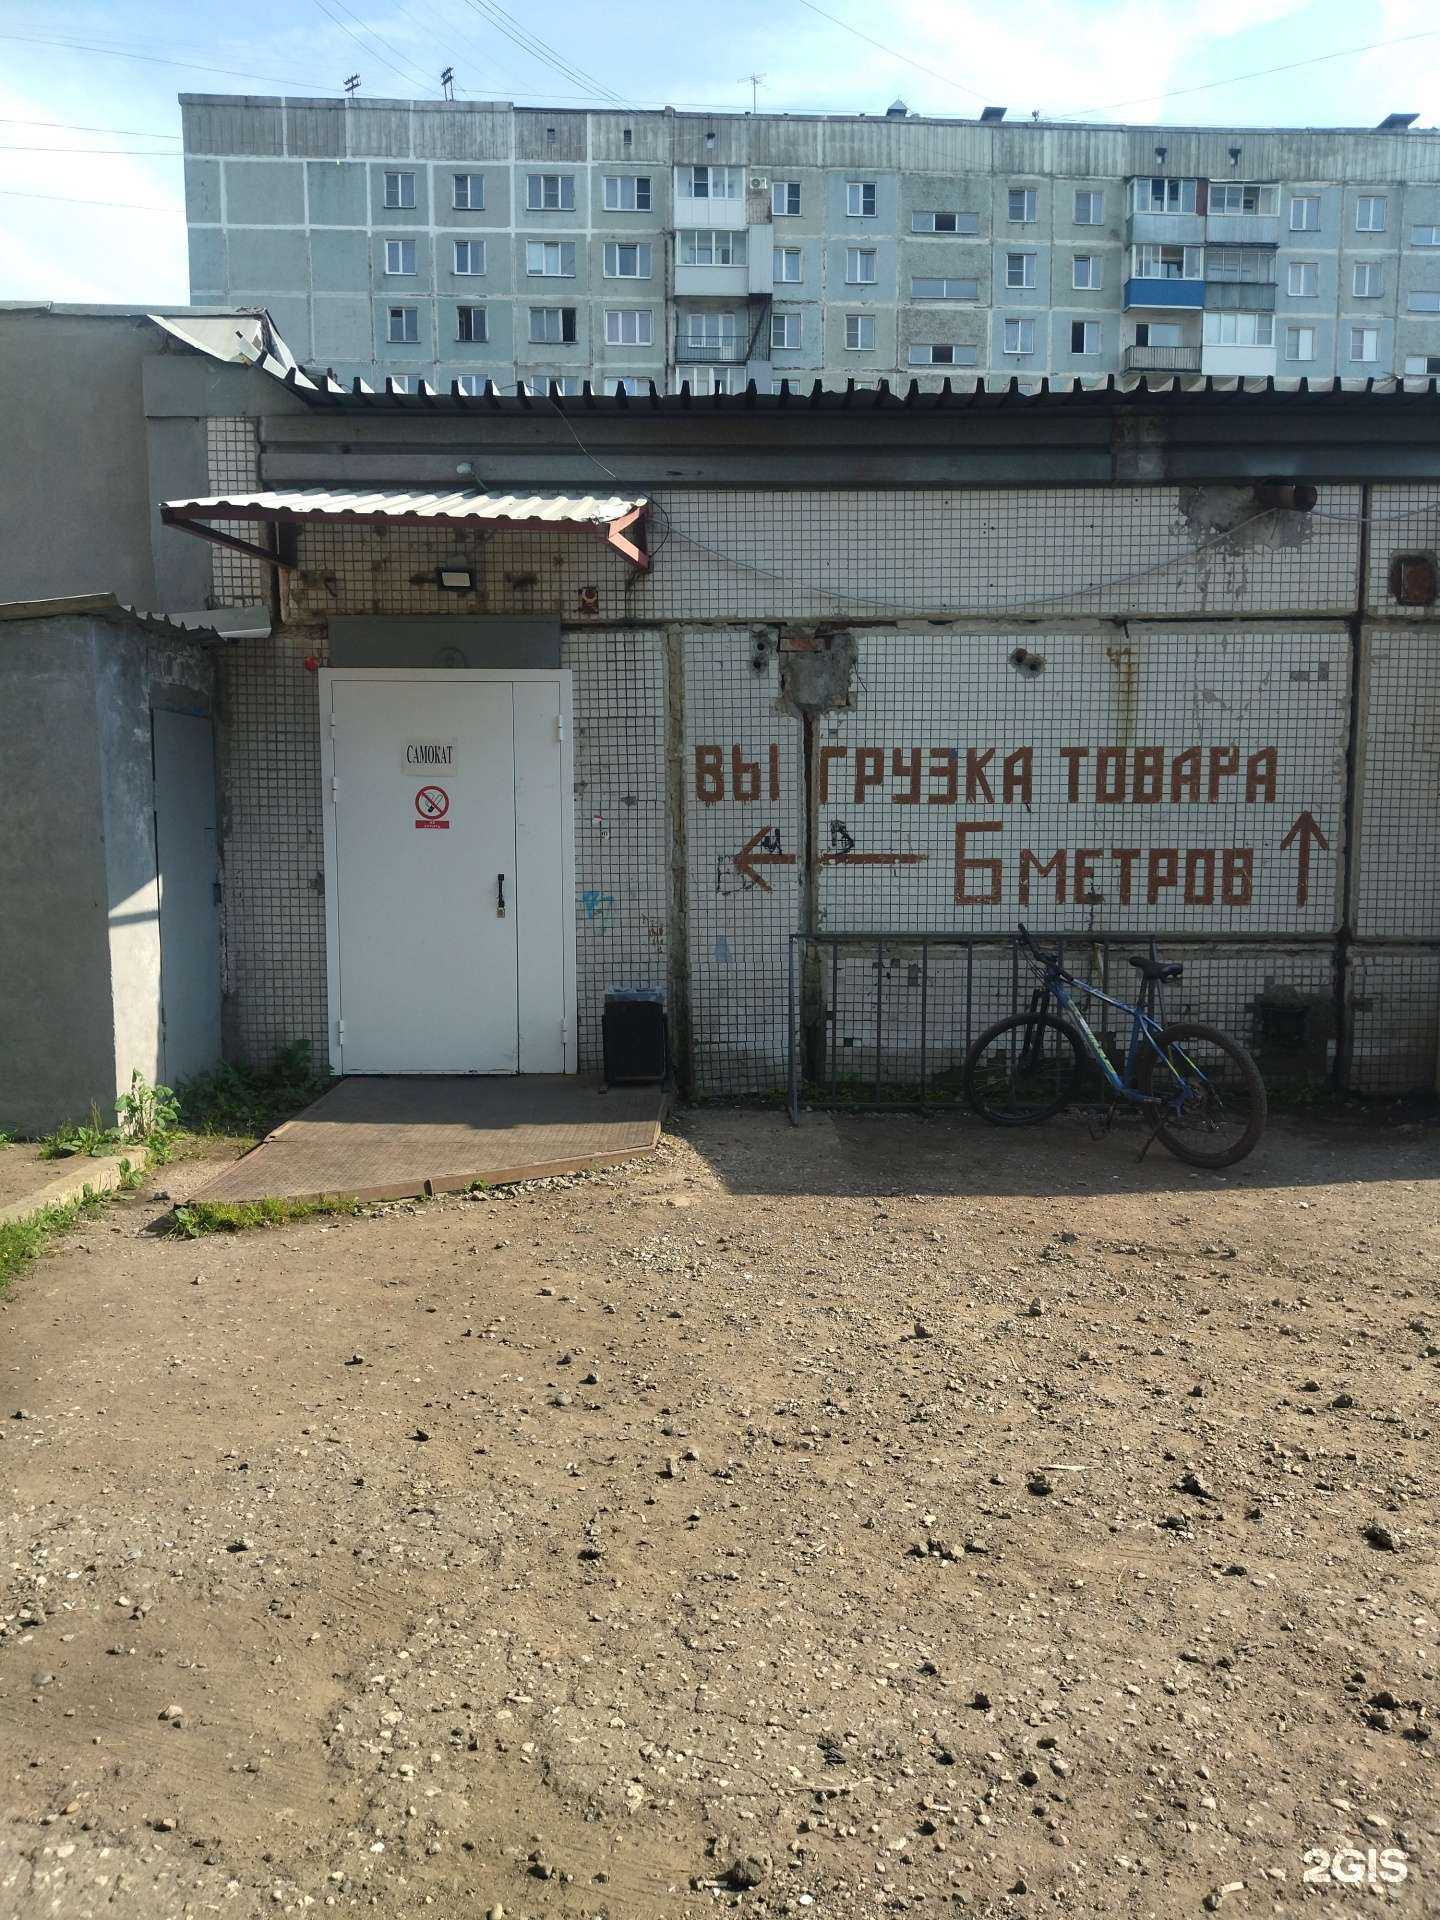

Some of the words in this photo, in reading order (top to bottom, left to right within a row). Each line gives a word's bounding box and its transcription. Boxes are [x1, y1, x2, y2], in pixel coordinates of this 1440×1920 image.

[406, 744, 453, 764] САМОКАТ
[1060, 745, 1278, 804] ТОВАРА
[1019, 847, 1254, 907] МЕТРОВ
